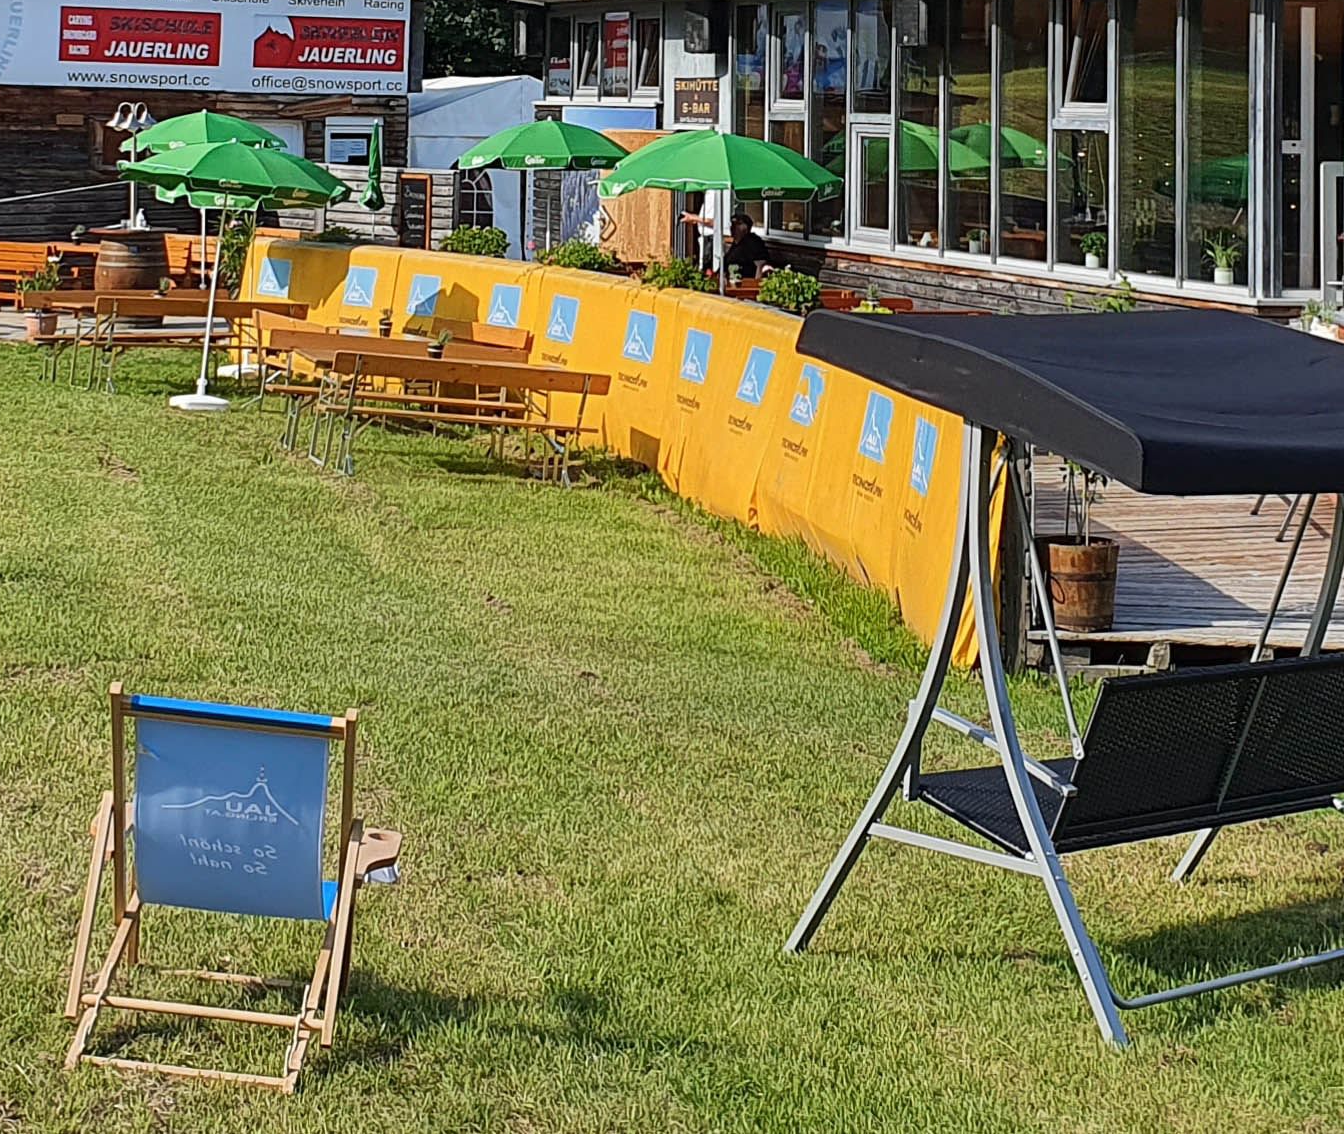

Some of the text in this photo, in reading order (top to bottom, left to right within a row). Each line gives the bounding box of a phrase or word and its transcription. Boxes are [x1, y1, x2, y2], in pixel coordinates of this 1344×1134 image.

[110, 16, 215, 35] SKISCHULE
[104, 41, 209, 60] JAUERLING
[298, 47, 397, 65] JAUERLING
[67, 72, 210, 87] www.snowsport.cc
[252, 76, 402, 91] office@snowsport.cc
[675, 78, 718, 91] SKIHÜTTE
[682, 102, 711, 114] S-BAR
